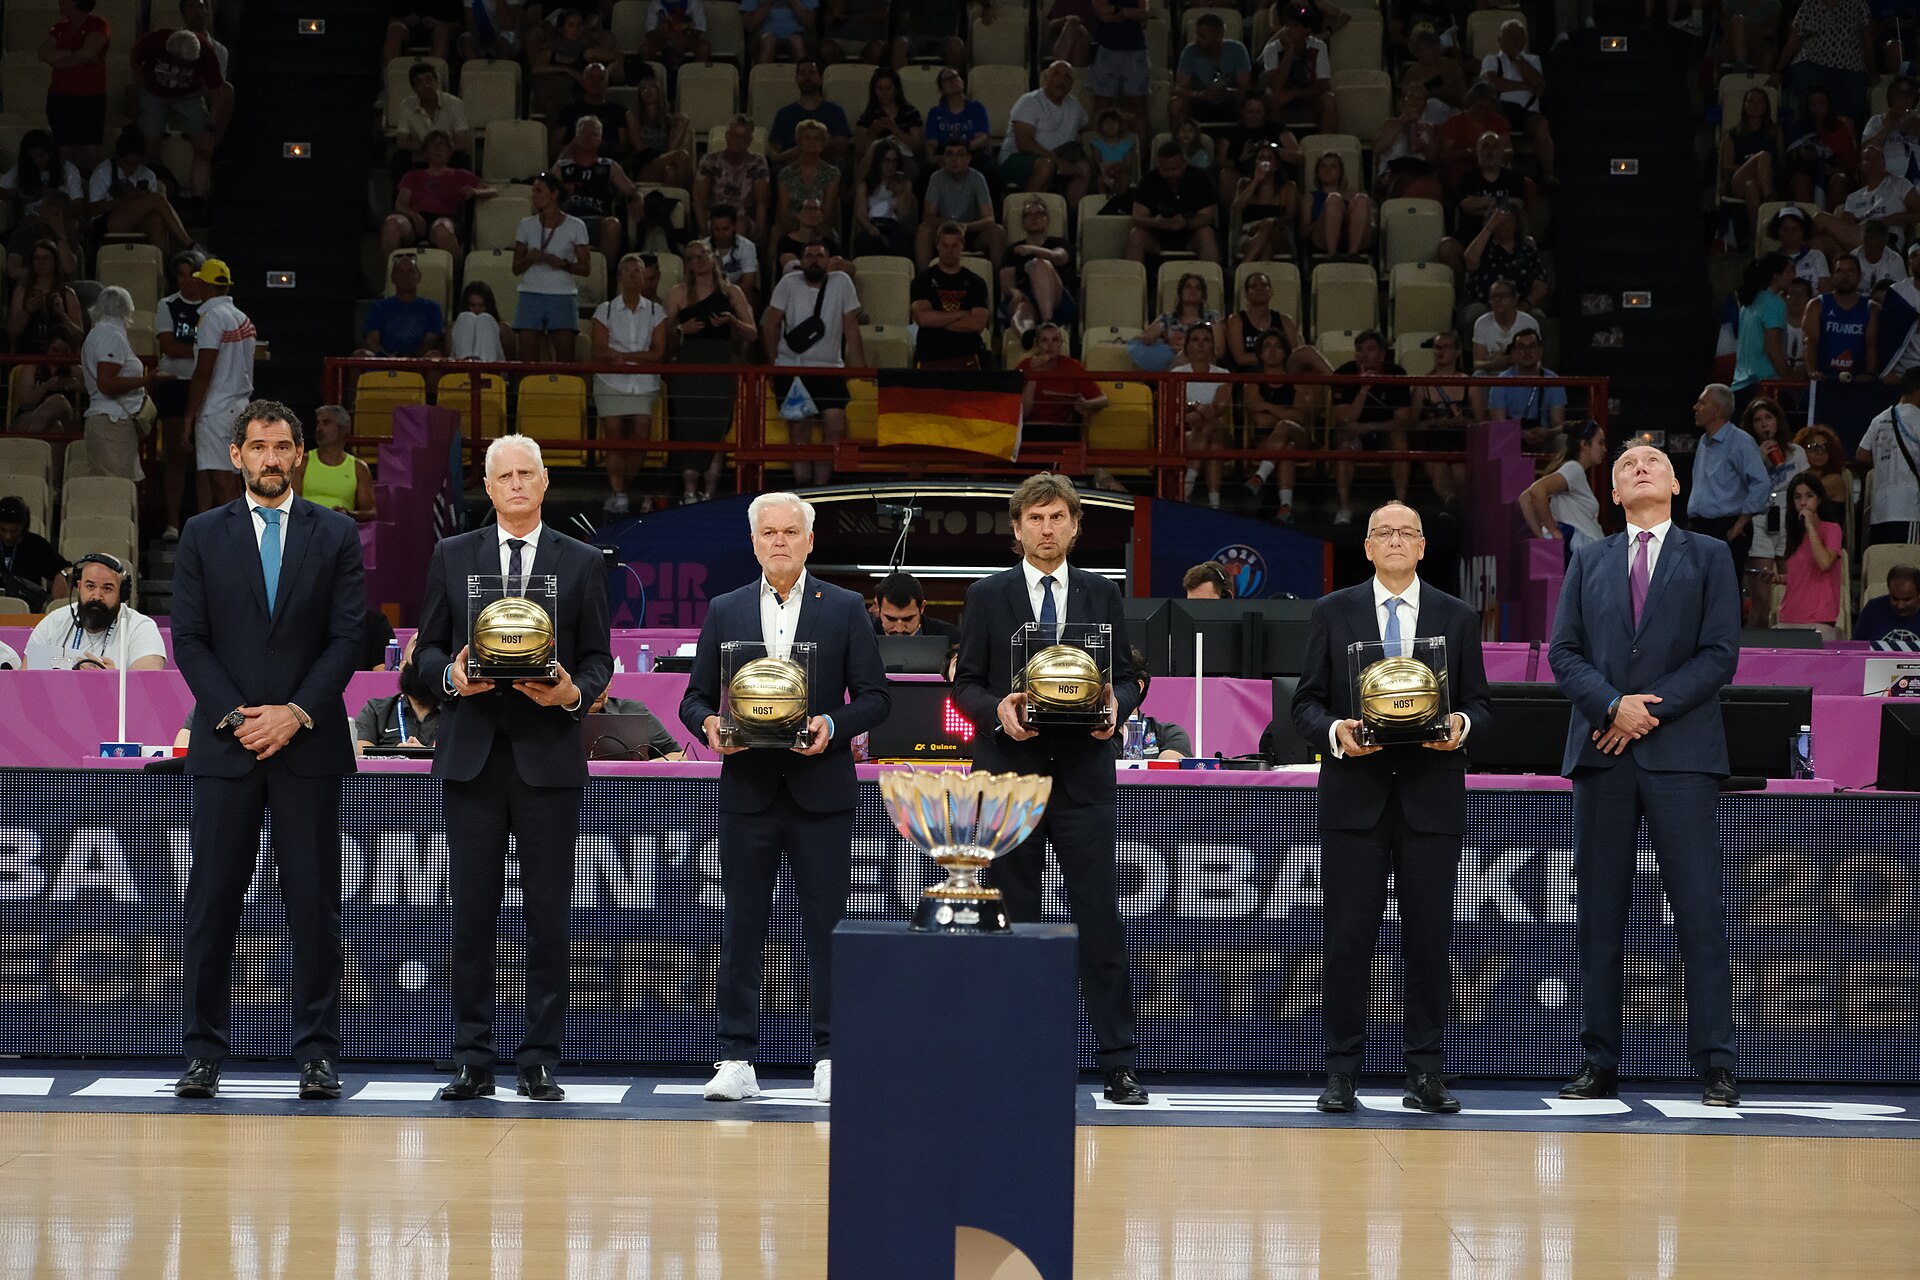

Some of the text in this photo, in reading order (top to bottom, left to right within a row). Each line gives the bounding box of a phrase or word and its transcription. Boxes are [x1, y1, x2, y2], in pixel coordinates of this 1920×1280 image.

[1884, 134, 1920, 146] RANC
[1826, 321, 1864, 335] FRANCE
[625, 562, 709, 599] PIR
[501, 635, 523, 644] HOST
[1058, 684, 1079, 694] HOST
[1393, 698, 1414, 709] HOST
[752, 706, 773, 715] HOST
[930, 743, 957, 751] Quince
